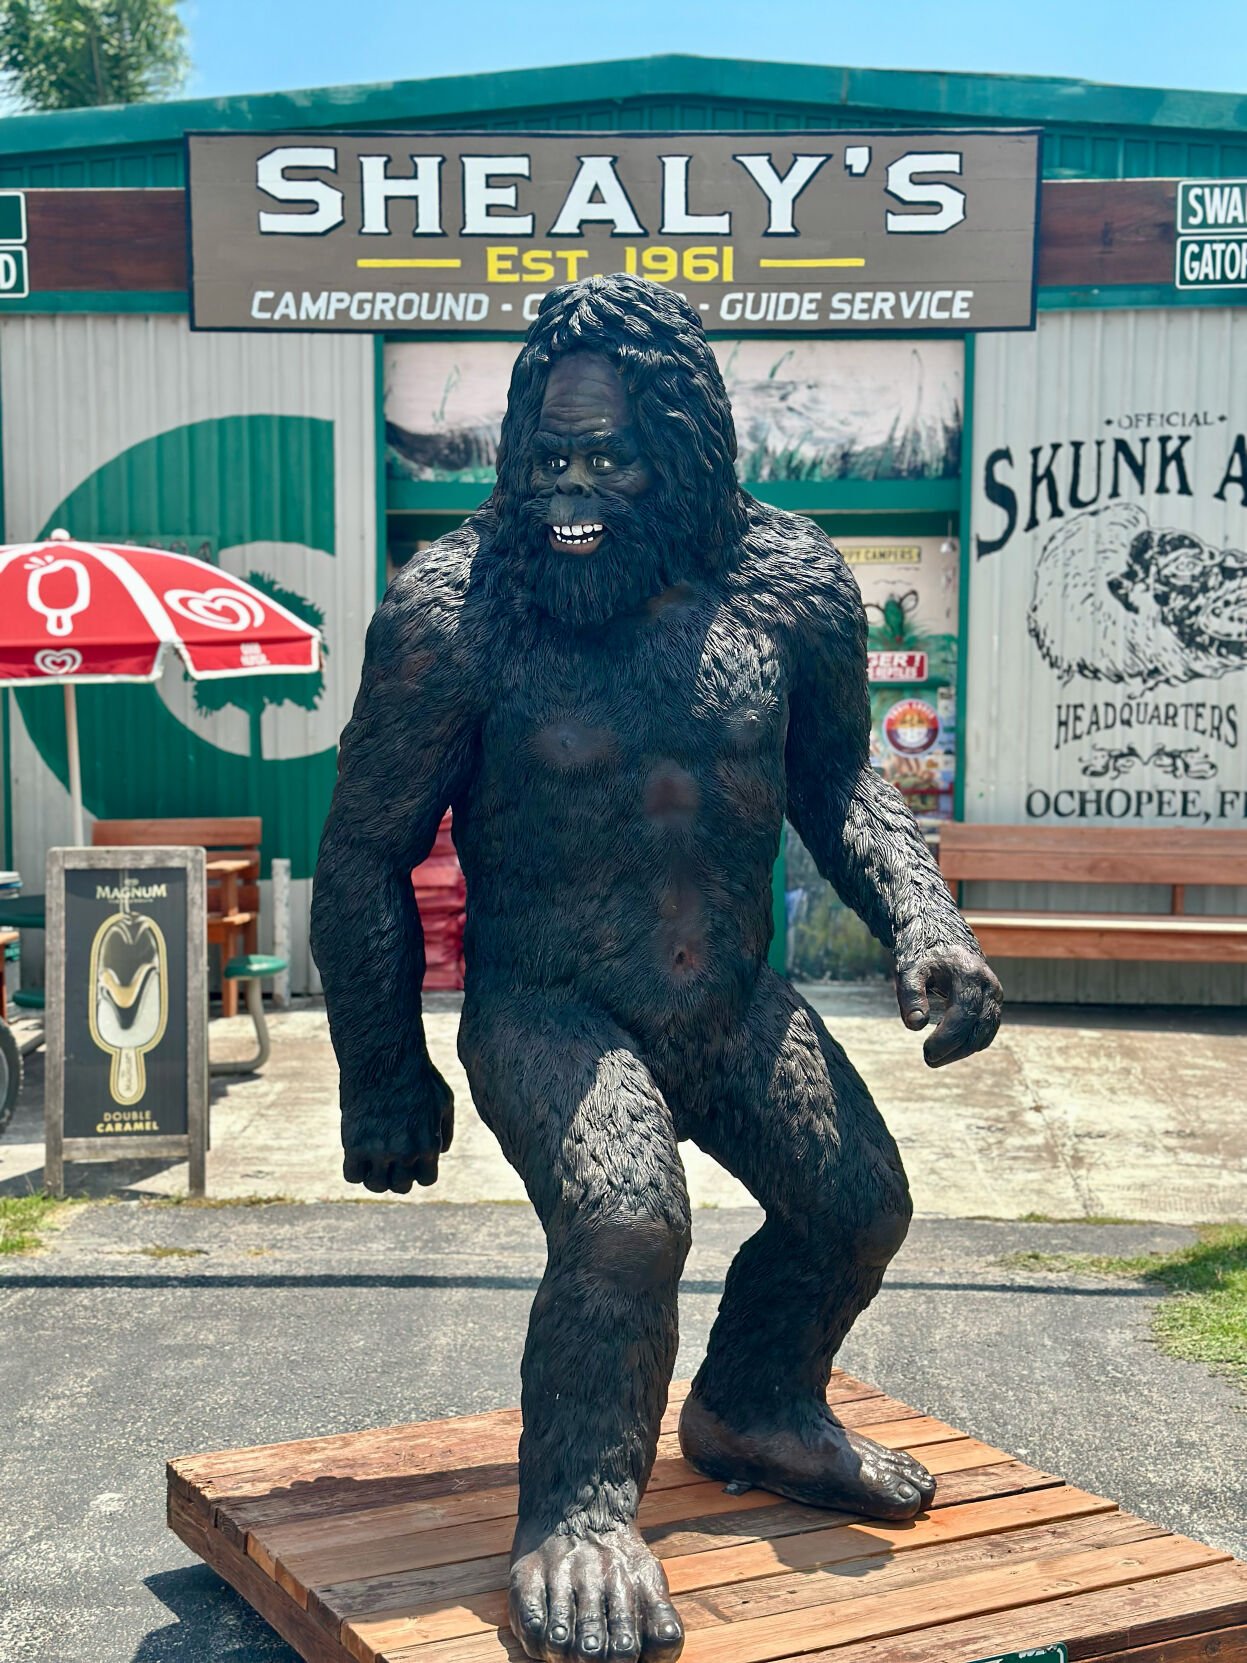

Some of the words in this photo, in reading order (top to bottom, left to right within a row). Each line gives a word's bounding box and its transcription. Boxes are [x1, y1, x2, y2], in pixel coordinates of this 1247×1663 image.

[256, 146, 967, 236] SHEALY'S
[1187, 186, 1247, 226] SWA
[625, 246, 735, 283] 1961
[250, 290, 489, 322] CAMPGROUND
[720, 291, 820, 322] GUIDE
[829, 289, 974, 321] SERVICE
[1118, 410, 1215, 430] OFFICIAL
[976, 433, 1193, 562] SKUNK
[1054, 702, 1239, 750] HEADQUARTERS
[96, 1121, 160, 1133] CARAMEL
[103, 1110, 152, 1122] DOUBLE
